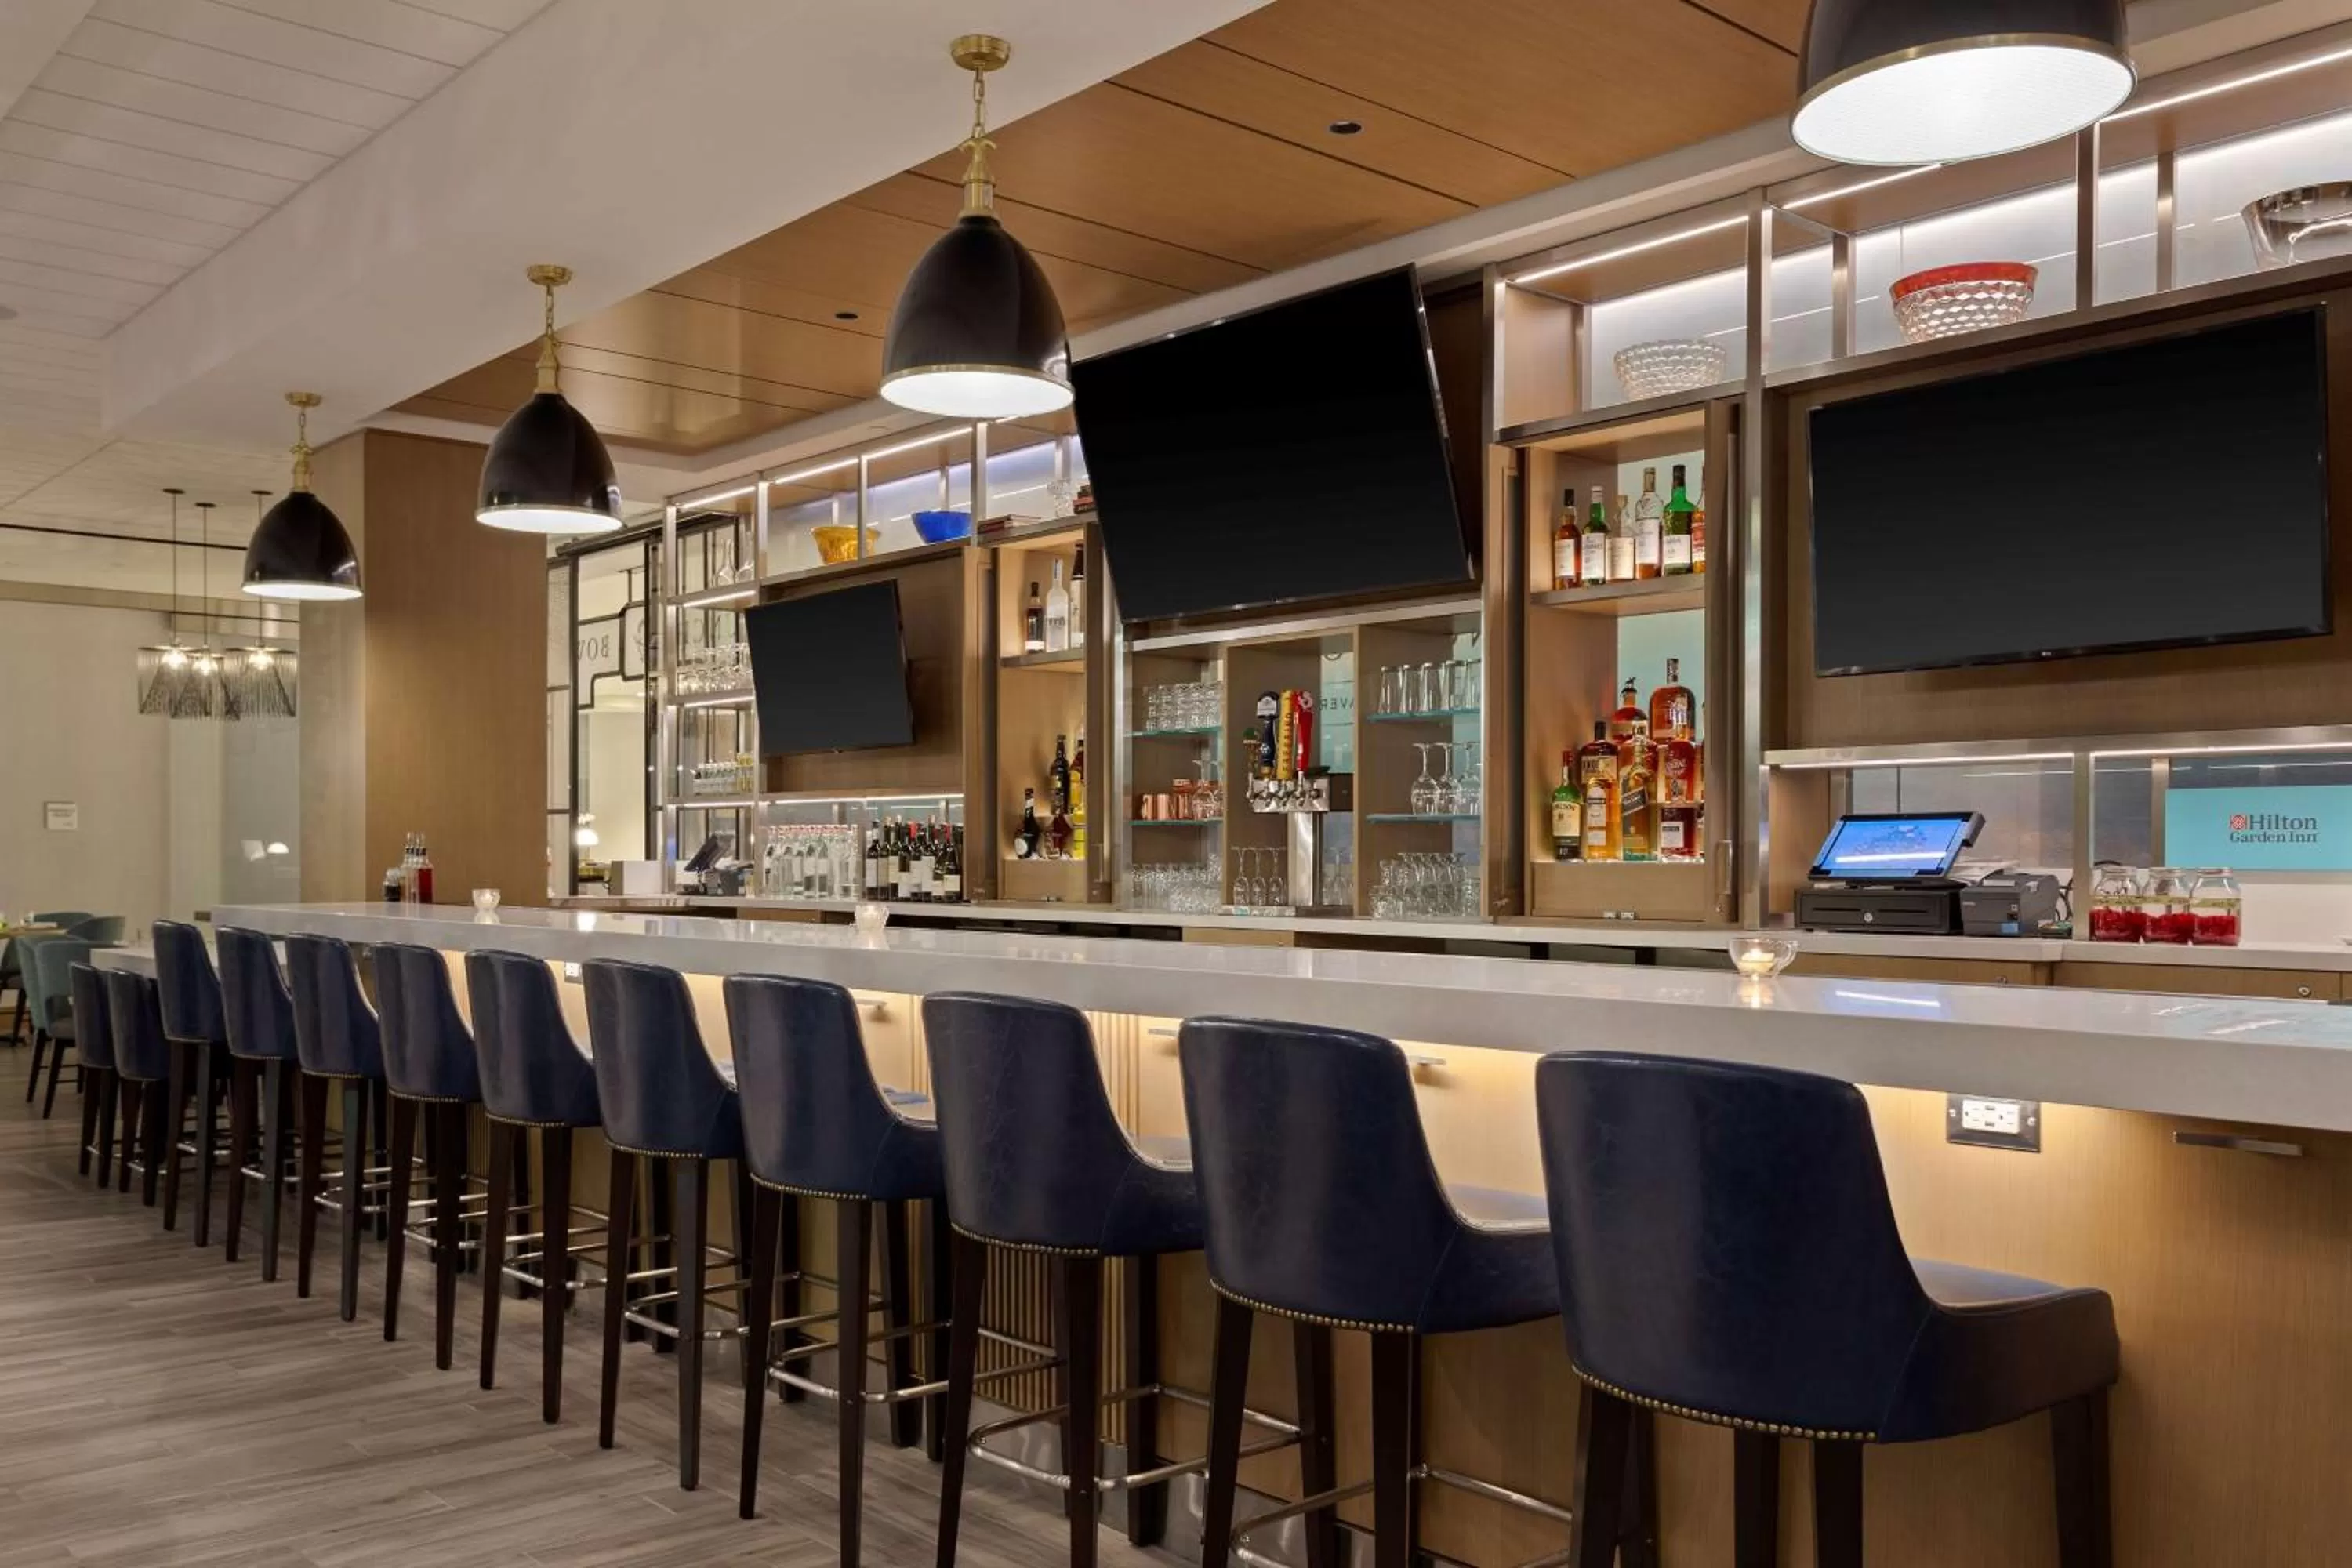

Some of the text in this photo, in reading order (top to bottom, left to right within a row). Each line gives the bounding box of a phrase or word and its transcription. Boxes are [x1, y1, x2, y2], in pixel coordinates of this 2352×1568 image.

[2249, 814, 2318, 830] Hilton
[2230, 831, 2318, 843] Garden Inn
